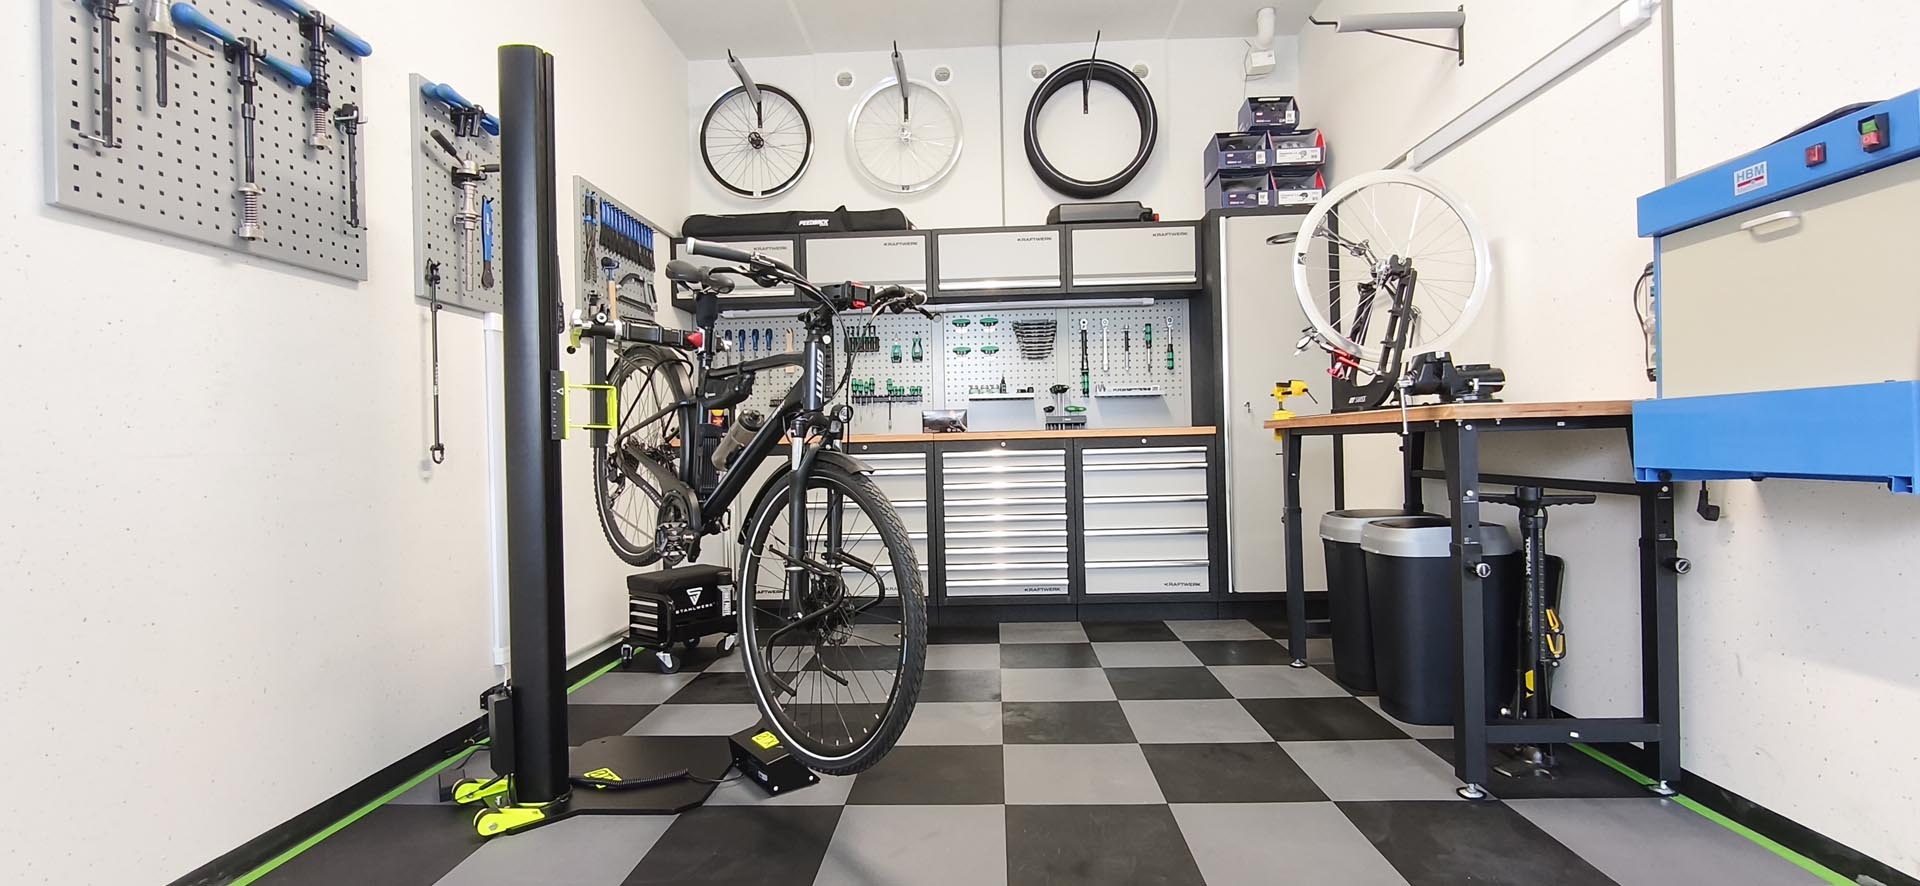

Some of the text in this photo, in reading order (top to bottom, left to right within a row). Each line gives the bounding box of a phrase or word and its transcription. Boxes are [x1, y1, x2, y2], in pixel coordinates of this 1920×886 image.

[1736, 163, 1765, 183] HBM
[816, 348, 824, 404] GIANT
[675, 602, 713, 615] STAHLWERK
